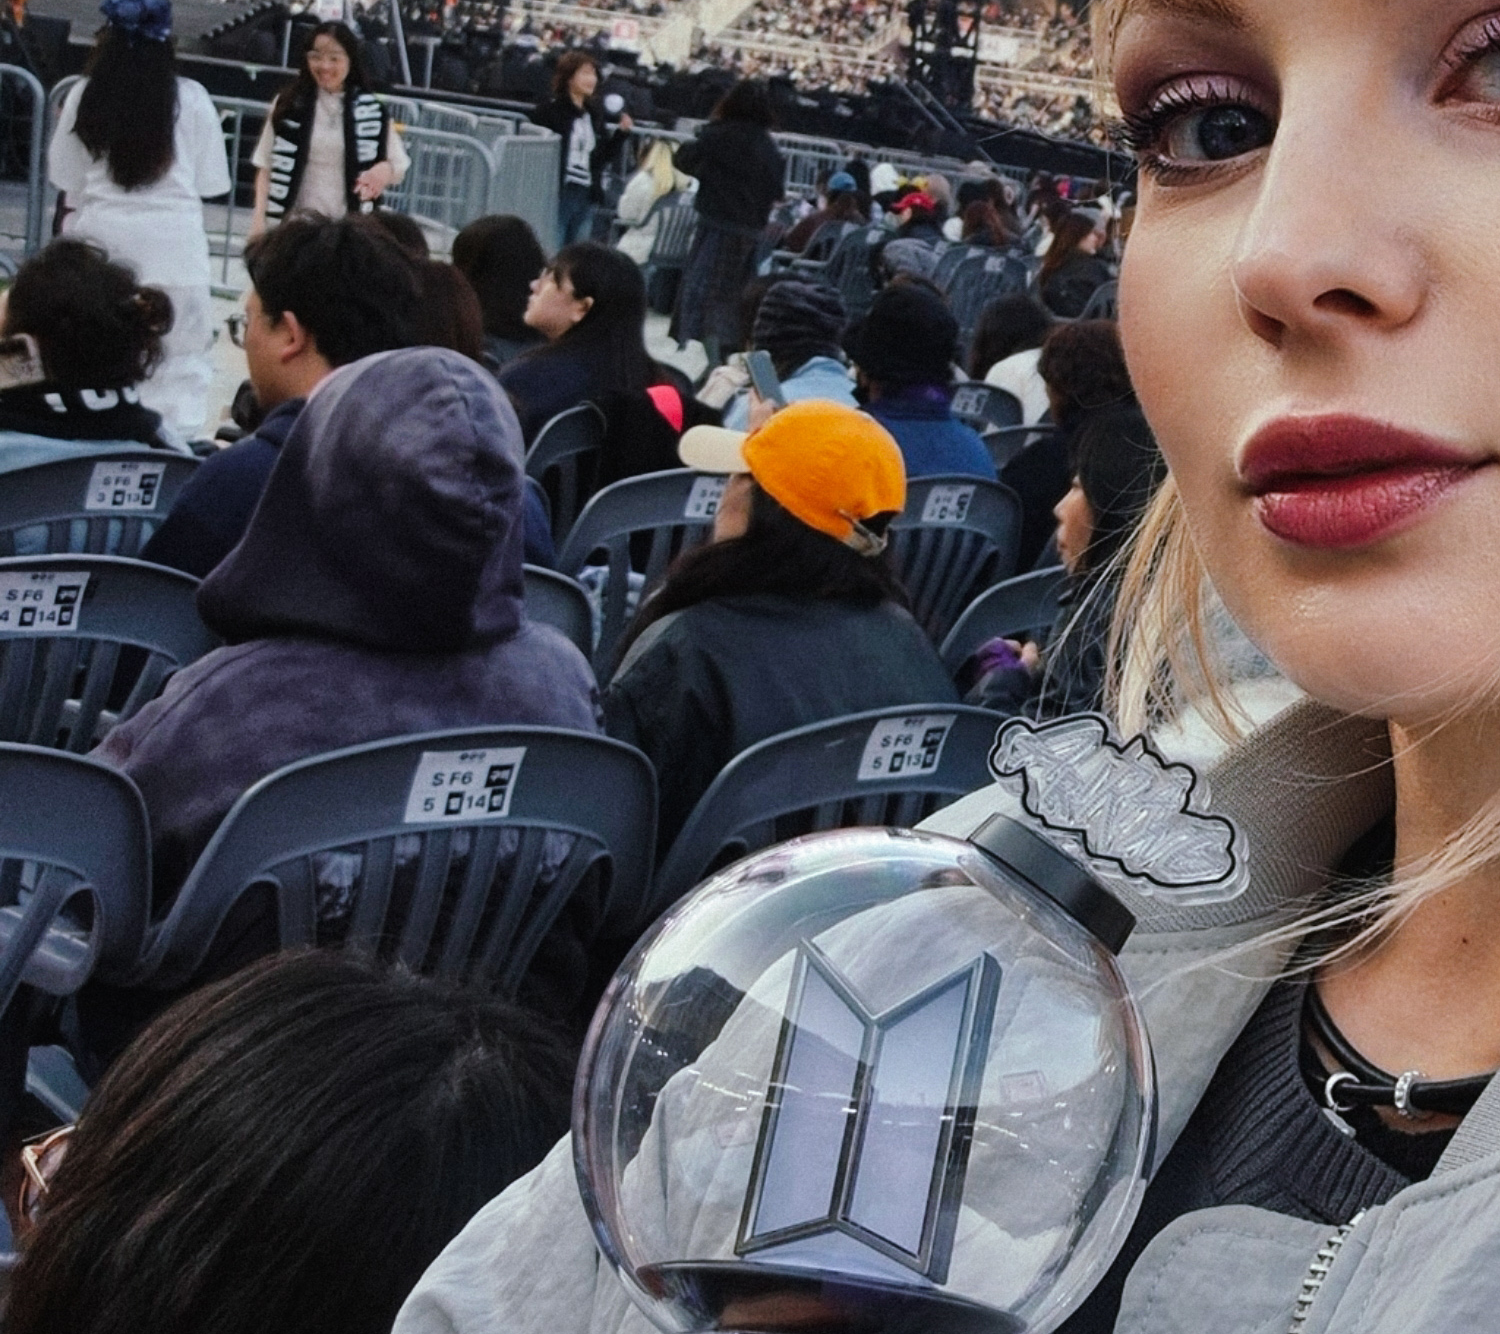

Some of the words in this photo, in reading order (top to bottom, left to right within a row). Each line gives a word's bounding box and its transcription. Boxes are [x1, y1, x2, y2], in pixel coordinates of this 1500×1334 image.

[6, 588, 18, 601] S
[22, 588, 43, 602] F6
[0, 610, 9, 622] 4
[39, 610, 56, 623] 14
[881, 735, 892, 748] S
[895, 733, 913, 747] F6
[907, 753, 921, 767] 13
[432, 772, 445, 787] S
[449, 771, 473, 786] F6
[423, 797, 435, 812] 5
[467, 795, 486, 809] 14
